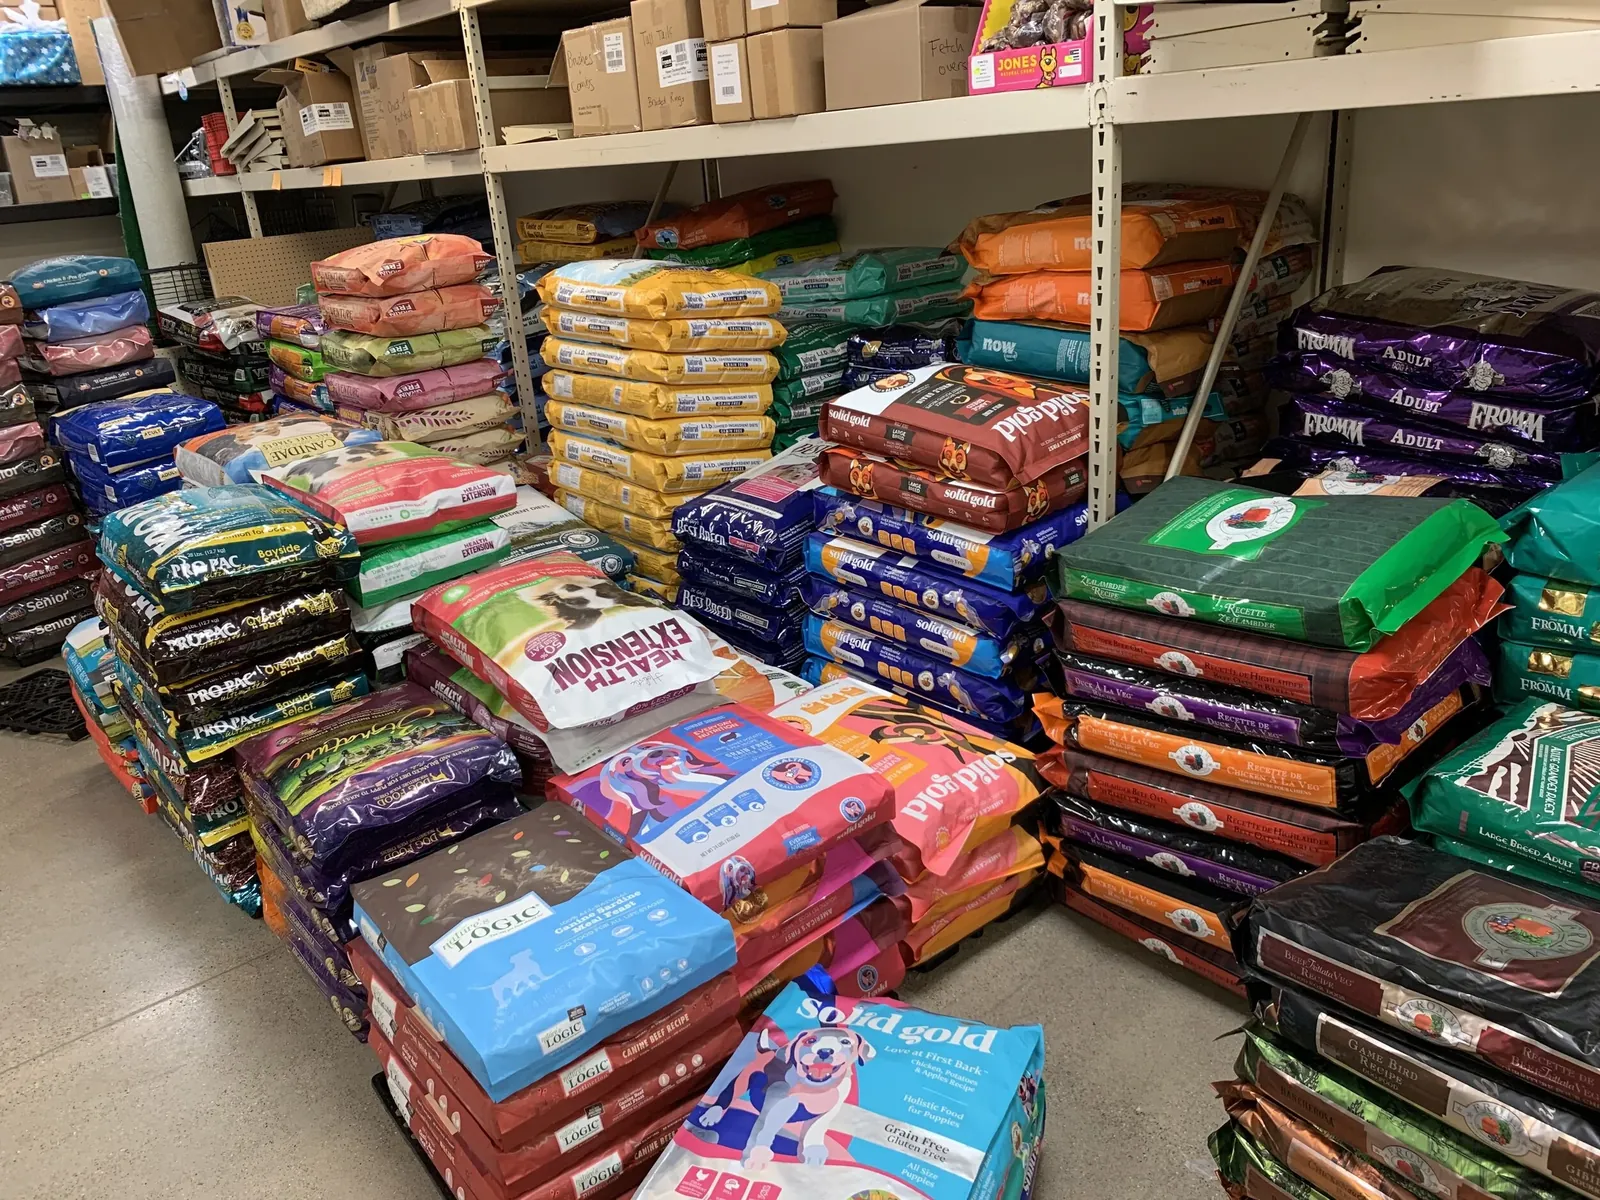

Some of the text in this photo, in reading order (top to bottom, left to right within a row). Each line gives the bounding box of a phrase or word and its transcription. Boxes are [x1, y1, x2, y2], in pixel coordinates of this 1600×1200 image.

[929, 37, 964, 58] Fetch
[997, 54, 1038, 71] JONES
[1074, 237, 1092, 250] no
[983, 336, 1017, 354] now
[1297, 328, 1355, 361] FROMM
[1382, 345, 1432, 369] ADULT
[1389, 388, 1442, 415] ADULT
[991, 391, 1091, 443] solid gold
[1303, 411, 1365, 447] FROMM
[1467, 401, 1546, 443] FROMM
[271, 438, 337, 463] CANIDAE
[1390, 428, 1444, 451] ADULT
[461, 486, 497, 503] EXTENSION
[463, 482, 490, 494] HEALTH
[257, 542, 302, 558] Bayside
[461, 541, 496, 558] EXTENSION
[463, 537, 489, 550] HEALTH
[208, 555, 242, 574] PAC
[26, 590, 71, 614] Senior
[682, 589, 704, 608] BEST
[705, 597, 733, 620] BREED
[1224, 601, 1267, 618] RECETTE
[35, 614, 77, 635] Senior
[1531, 616, 1585, 640] FROMM
[545, 616, 694, 692] EXTENSION
[584, 648, 687, 693] HEALTH
[188, 672, 258, 706] PRO PAC
[1520, 677, 1572, 701] FROMM
[193, 711, 262, 740] PRO PAC
[693, 719, 733, 737] EVERYDAY
[697, 723, 739, 740] NUTRITION
[1217, 711, 1270, 731] RECETTE DE
[1226, 765, 1273, 784] CHICKEN
[1247, 761, 1302, 781] RECETTE DE
[900, 748, 1017, 823] solid gold
[1479, 826, 1573, 869] LARGE BREED ADULT
[554, 891, 641, 935] Canine Sardine
[571, 901, 637, 934] Meal Feast
[452, 903, 541, 954] LOGIC
[546, 1021, 582, 1049] LOGIC
[622, 1013, 690, 1059] CANINE BEEF RECIPE
[796, 997, 998, 1055] Solid gold
[884, 1045, 983, 1076] Love at First Bark
[1348, 1038, 1419, 1082] GAME BIRD
[1358, 1053, 1404, 1086] RECIPE
[569, 1060, 609, 1090] LOGIC
[910, 1059, 979, 1088] Chicken, Potatoes
[923, 1069, 949, 1085] Apples
[950, 1078, 977, 1094] Recipe
[903, 1094, 965, 1121] Holistic Food
[907, 1103, 960, 1130] for Puppies
[564, 1119, 600, 1147] LOGIC
[884, 1122, 950, 1155] Grain Free
[634, 1140, 659, 1160] CANINE
[887, 1135, 947, 1164] Gluten Free
[580, 1161, 623, 1192] LOGIC
[901, 1168, 936, 1189] Puppies
[906, 1161, 939, 1181] All Size
